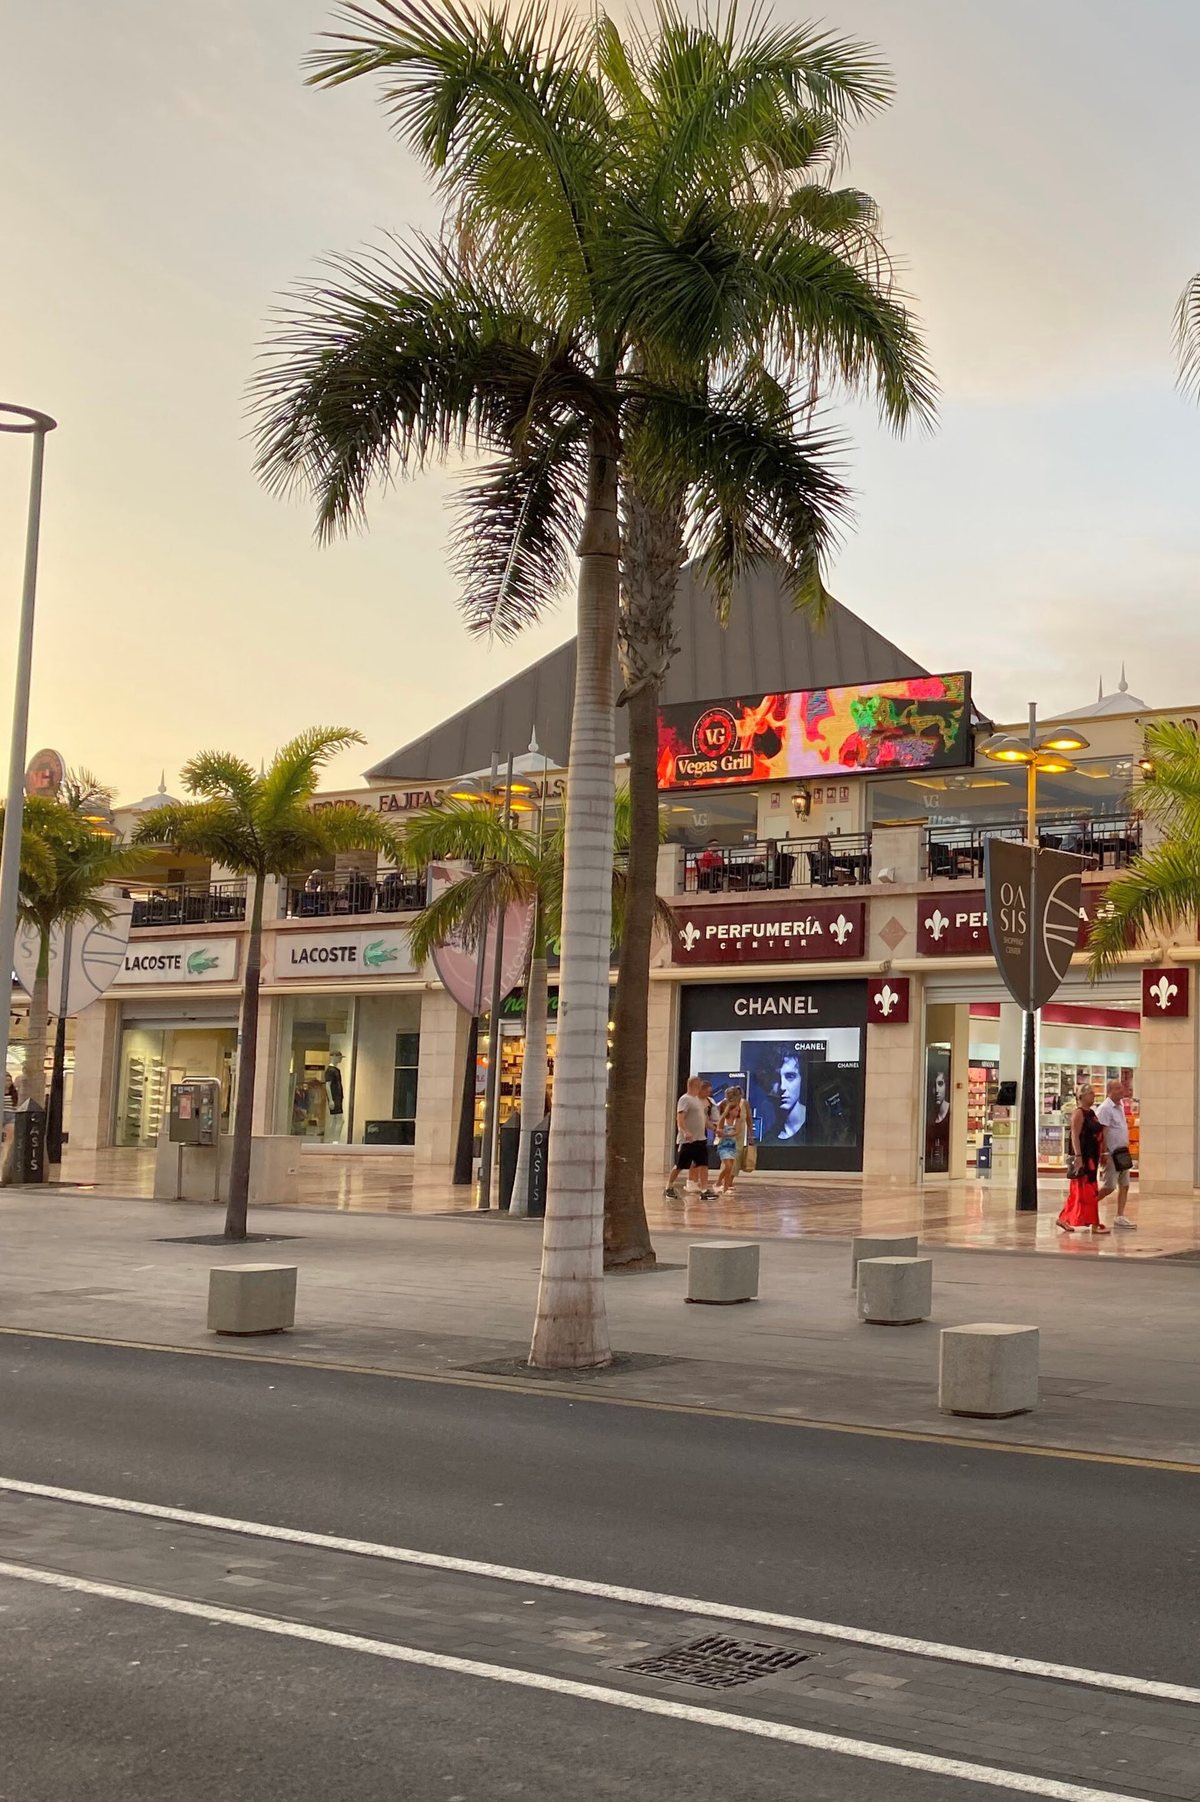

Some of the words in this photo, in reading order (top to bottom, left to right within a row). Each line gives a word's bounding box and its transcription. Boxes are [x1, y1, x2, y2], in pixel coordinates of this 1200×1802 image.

[705, 728, 726, 746] VG
[678, 758, 718, 778] Vegas
[721, 753, 752, 771] Grill
[378, 789, 444, 812] FAJITAS
[706, 915, 823, 939] PERFUMERÍA
[720, 940, 807, 950] CENTER
[125, 955, 181, 970] LACOSTE
[291, 946, 357, 964] LACOSTE
[734, 997, 819, 1016] CHANEL
[794, 1043, 826, 1051] CHANEL
[533, 1132, 543, 1201] OASIS
